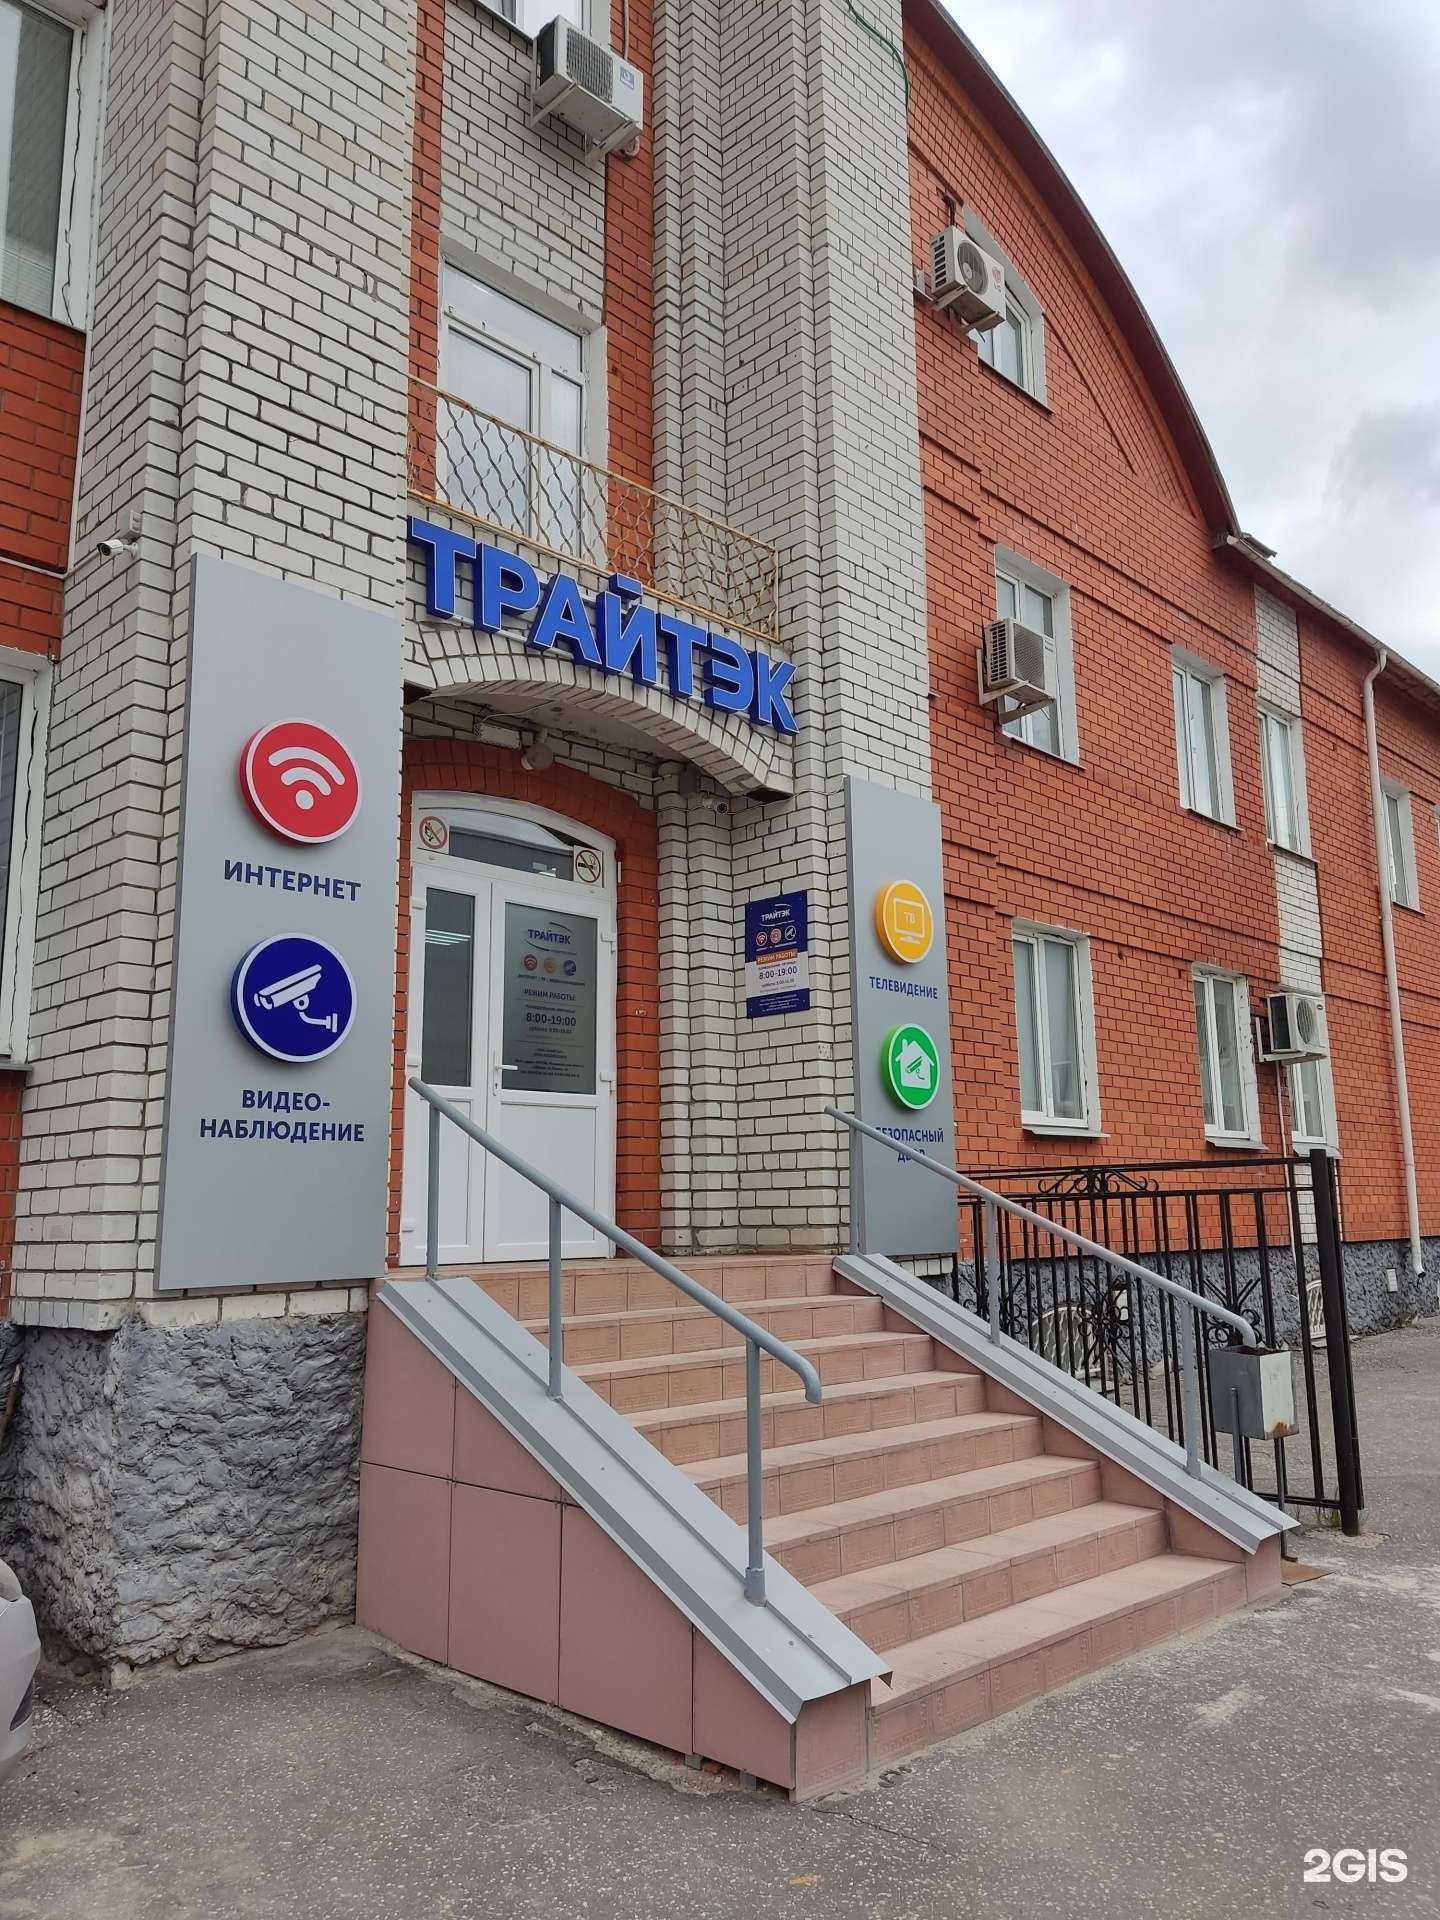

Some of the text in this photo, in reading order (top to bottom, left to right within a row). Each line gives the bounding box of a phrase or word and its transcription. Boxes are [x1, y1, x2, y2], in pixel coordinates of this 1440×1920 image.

[407, 515, 799, 736] ТРАЙТЭК
[224, 859, 362, 902] ИНТЕРНЕТ
[761, 908, 790, 922] ТРАЙТЭК
[527, 929, 571, 945] ТРАЙТЭК
[759, 965, 798, 980] 8:00-19:00
[524, 988, 576, 1001] РЕЖИМ РАБОТЫ
[869, 976, 938, 1000] ТЕЛЕВИДЕНИЕ
[526, 1012, 576, 1027] 8:00-19:00
[241, 1089, 330, 1113] ВИДЕО-
[200, 1118, 365, 1143] НАБЛЮДЕНИЕ
